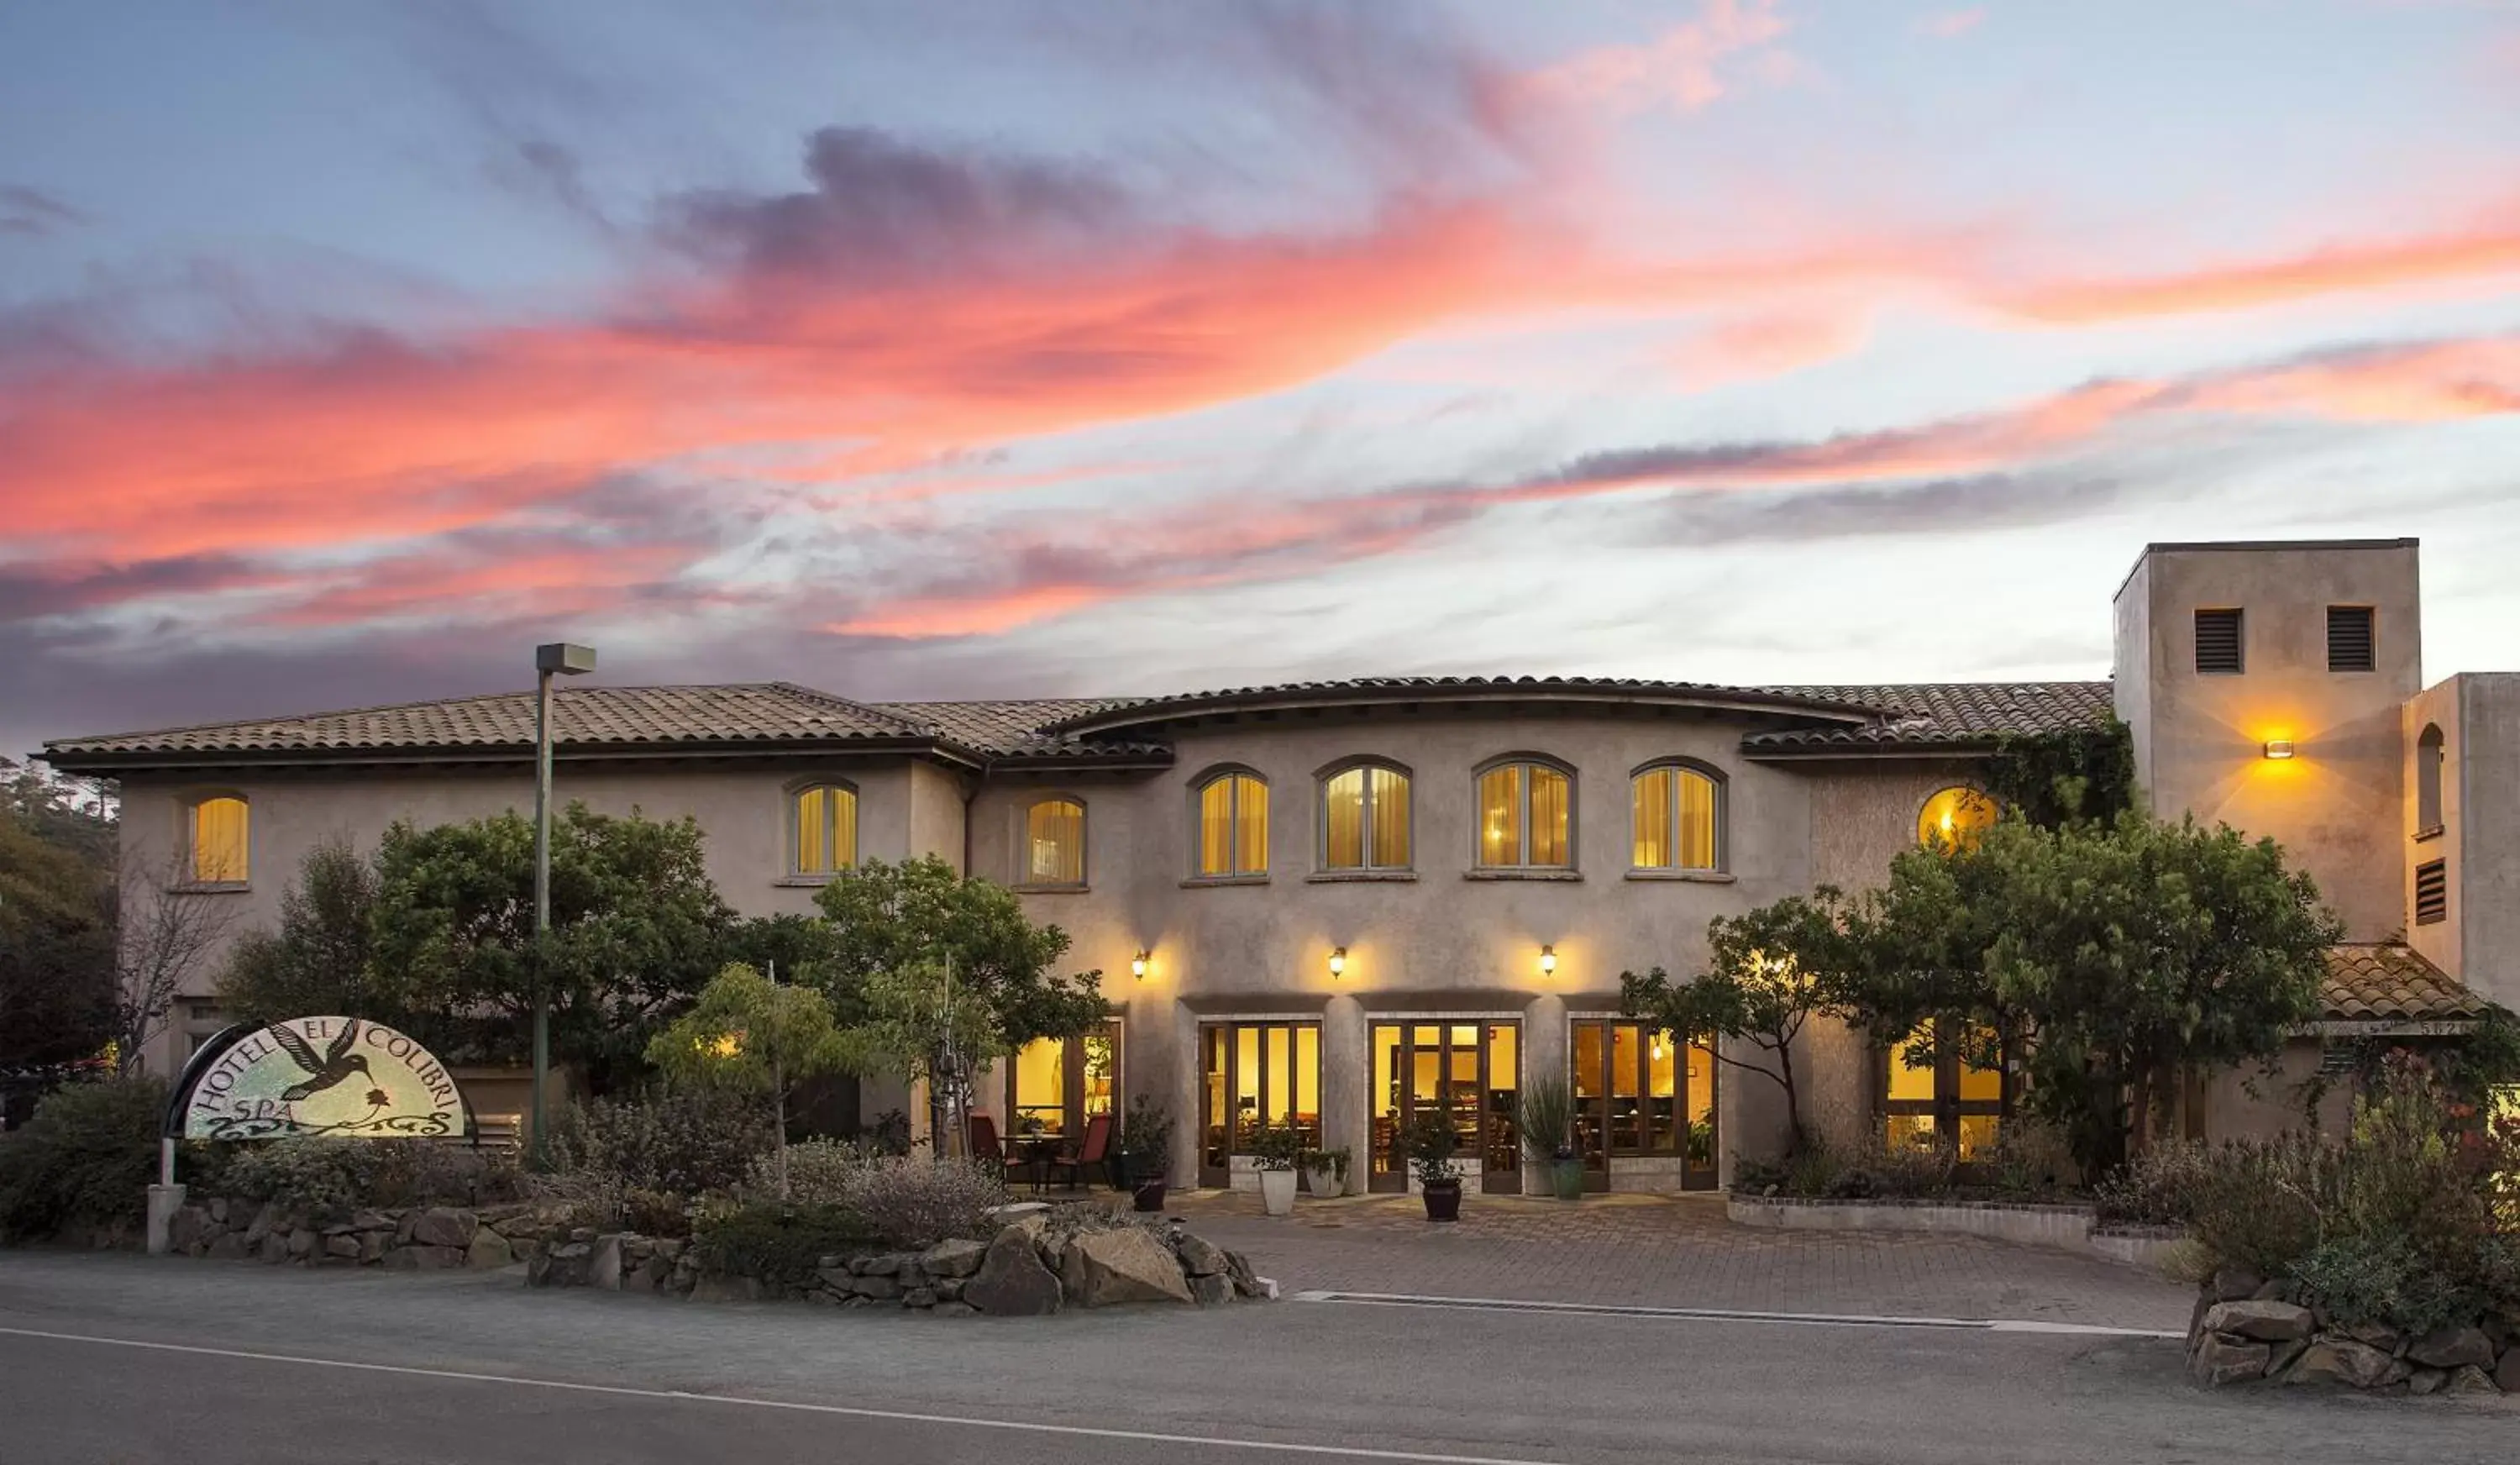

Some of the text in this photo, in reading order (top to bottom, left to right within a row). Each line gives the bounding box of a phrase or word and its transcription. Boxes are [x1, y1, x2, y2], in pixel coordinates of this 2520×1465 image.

[197, 1021, 458, 1111] HOTEL EL COLIBRI
[234, 1099, 294, 1122] SPA
